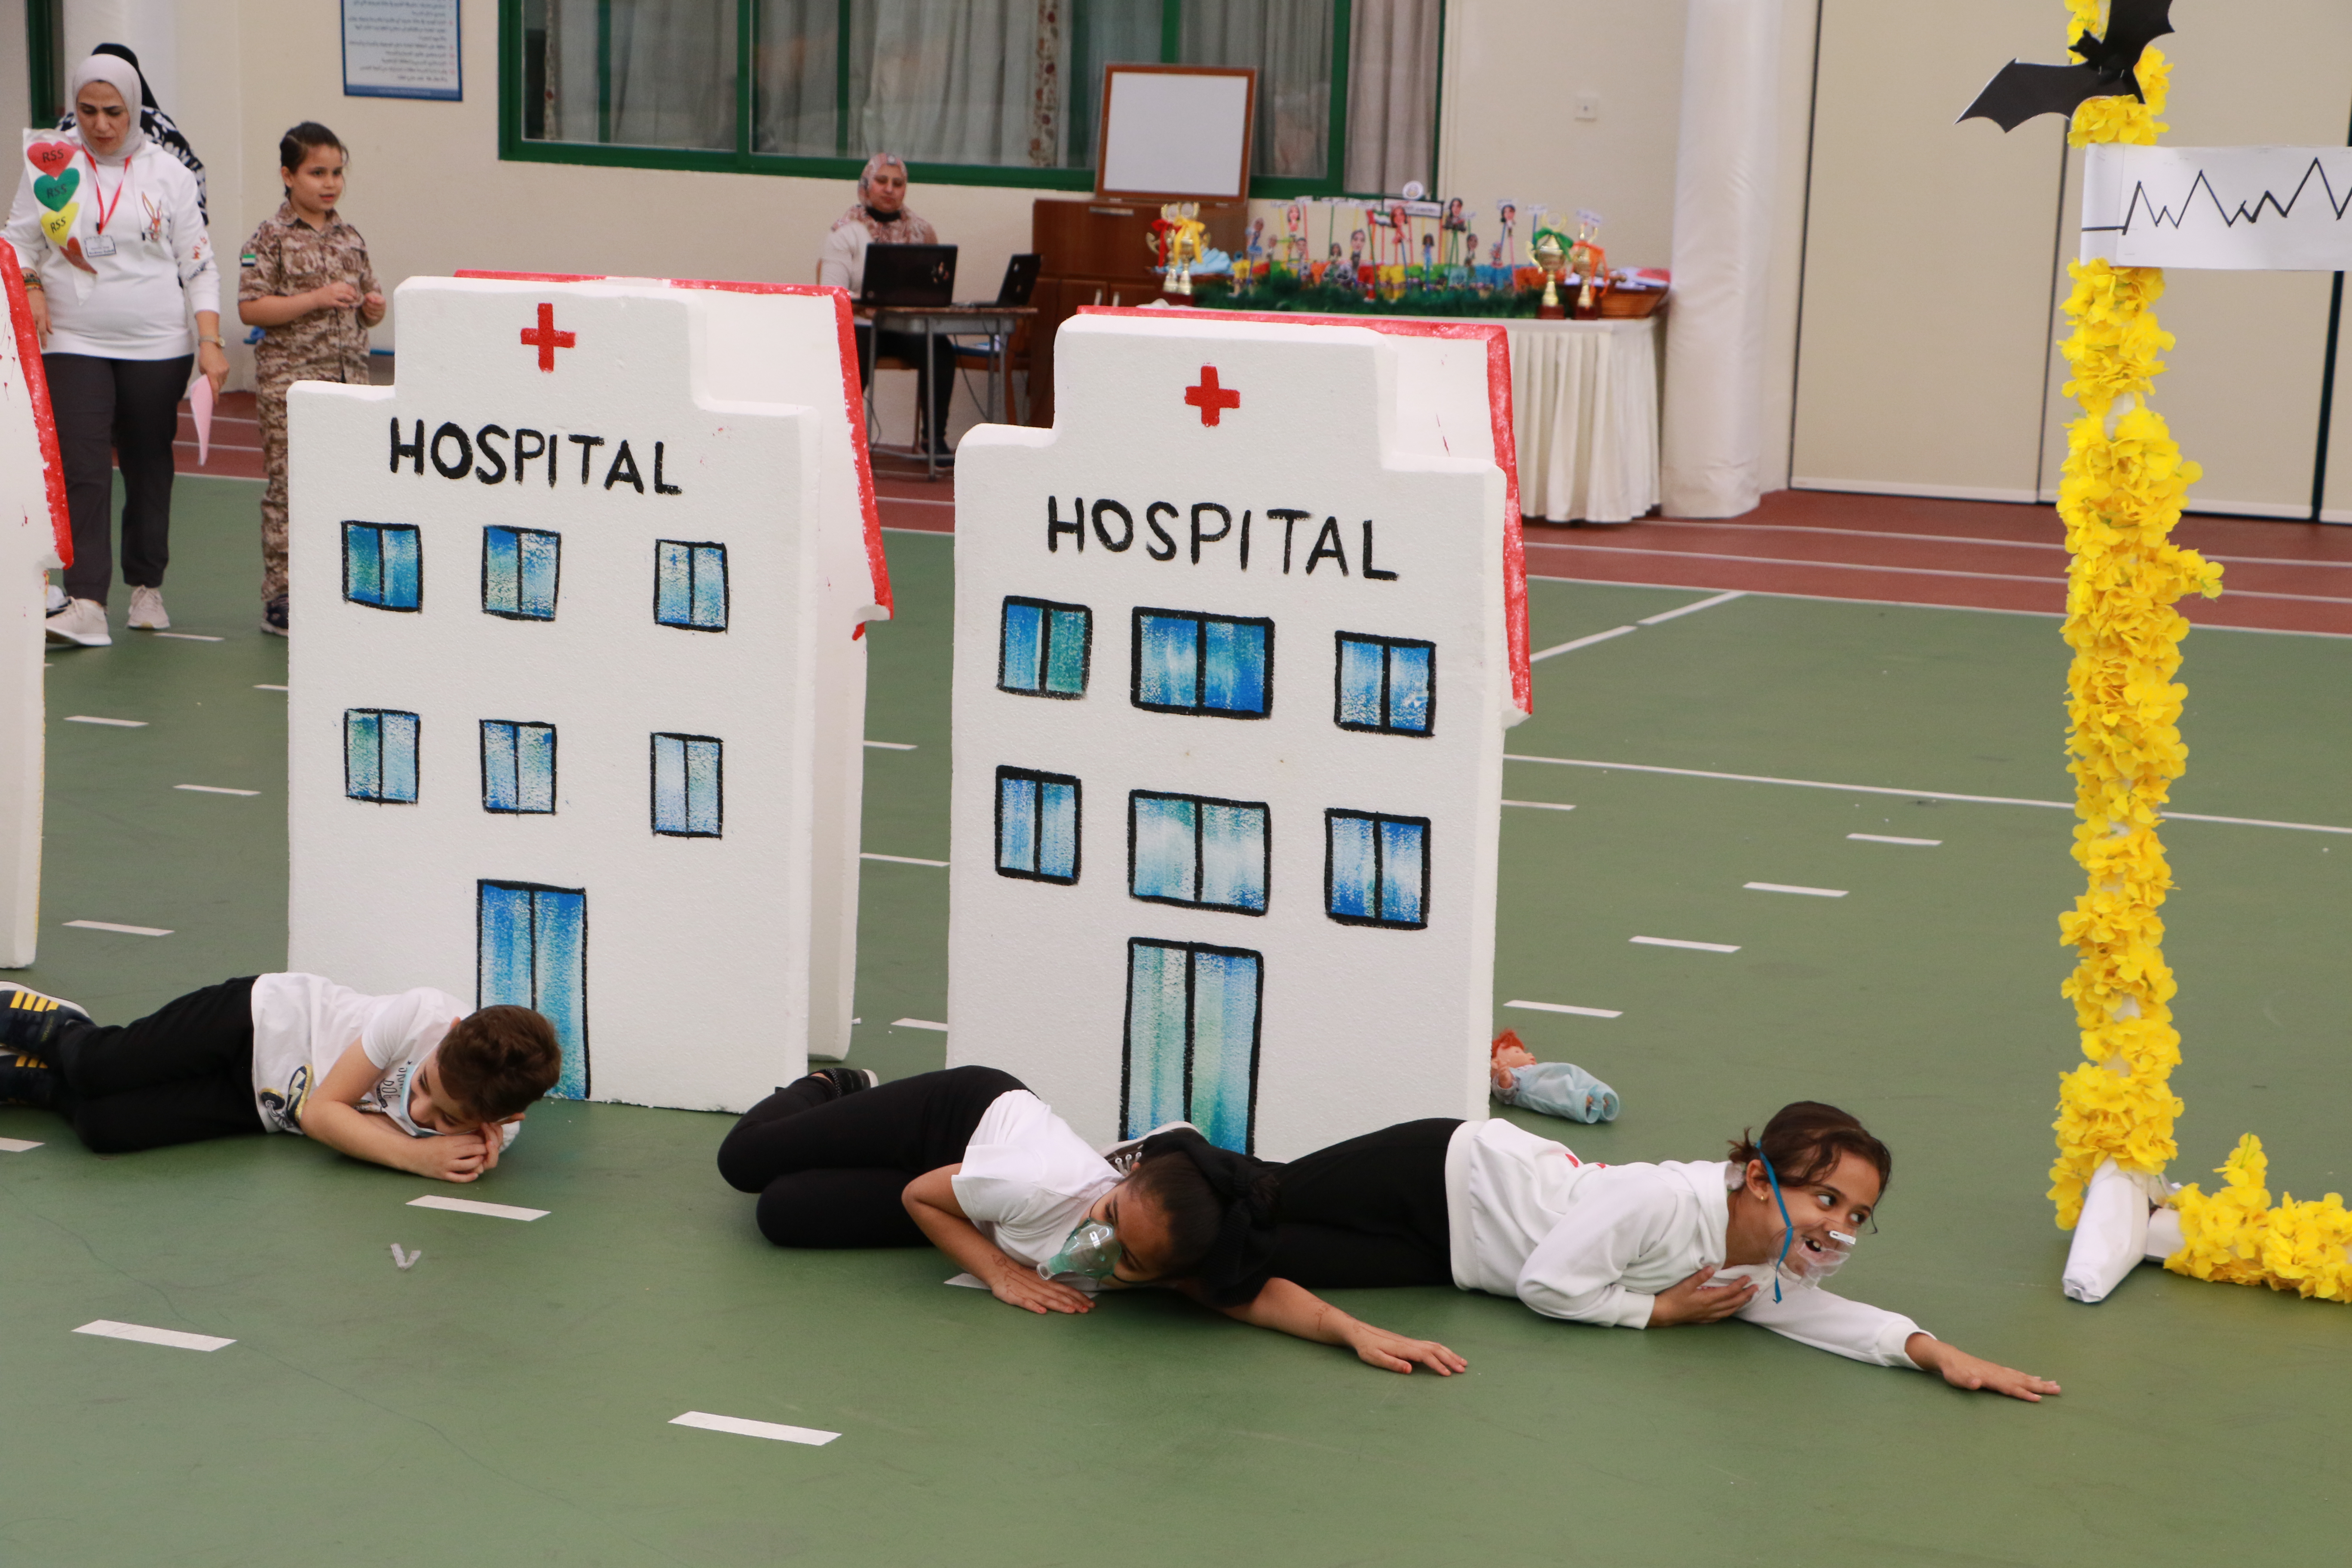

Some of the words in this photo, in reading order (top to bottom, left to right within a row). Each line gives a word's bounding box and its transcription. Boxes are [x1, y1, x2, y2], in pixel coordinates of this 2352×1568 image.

[42, 149, 64, 162] RSS
[46, 184, 67, 199] RSS
[50, 217, 66, 234] RSS
[390, 416, 683, 495] HOSPITAL
[1048, 495, 1400, 581] HOSPITAL
